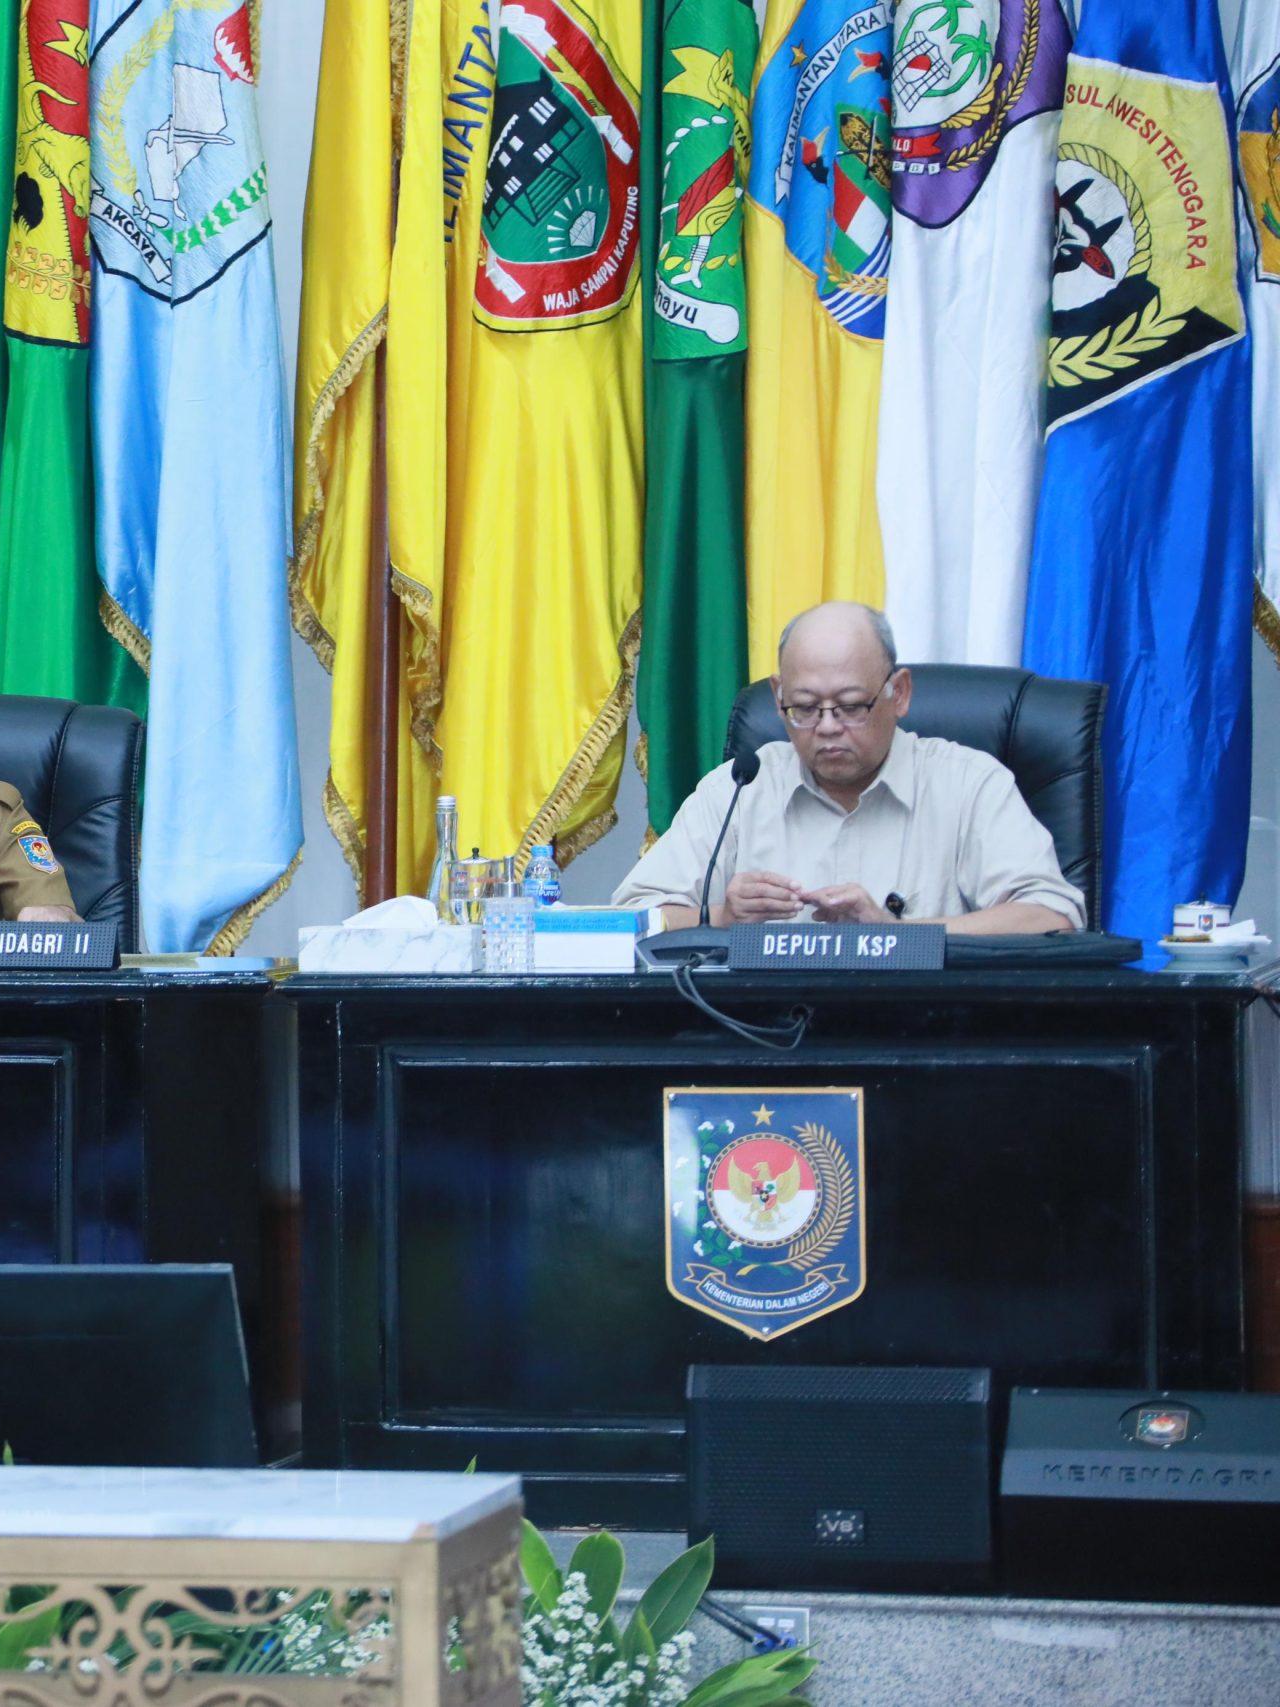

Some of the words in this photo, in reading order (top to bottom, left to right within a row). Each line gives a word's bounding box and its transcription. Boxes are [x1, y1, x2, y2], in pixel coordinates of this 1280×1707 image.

[784, 48, 836, 167] KALIMANTAN
[831, 12, 881, 54] UTARA
[443, 2, 497, 243] LIMANTA
[734, 120, 751, 158] TAN
[1066, 83, 1162, 145] SULAWESI
[1155, 135, 1208, 270] TENGGARA
[102, 203, 157, 266] AKCAYA
[542, 287, 580, 312] WAJA
[580, 255, 619, 299] SAMPAI
[613, 185, 639, 261] KAPUTING
[74, 933, 90, 954] II
[762, 934, 843, 957] DEPUTI
[856, 935, 899, 957] KSP
[703, 1280, 764, 1310] KEMENTERIAN
[764, 1296, 798, 1310] DALAM
[797, 1281, 830, 1306] NEGERI
[1041, 1463, 1273, 1487] KEMENDAGRI
